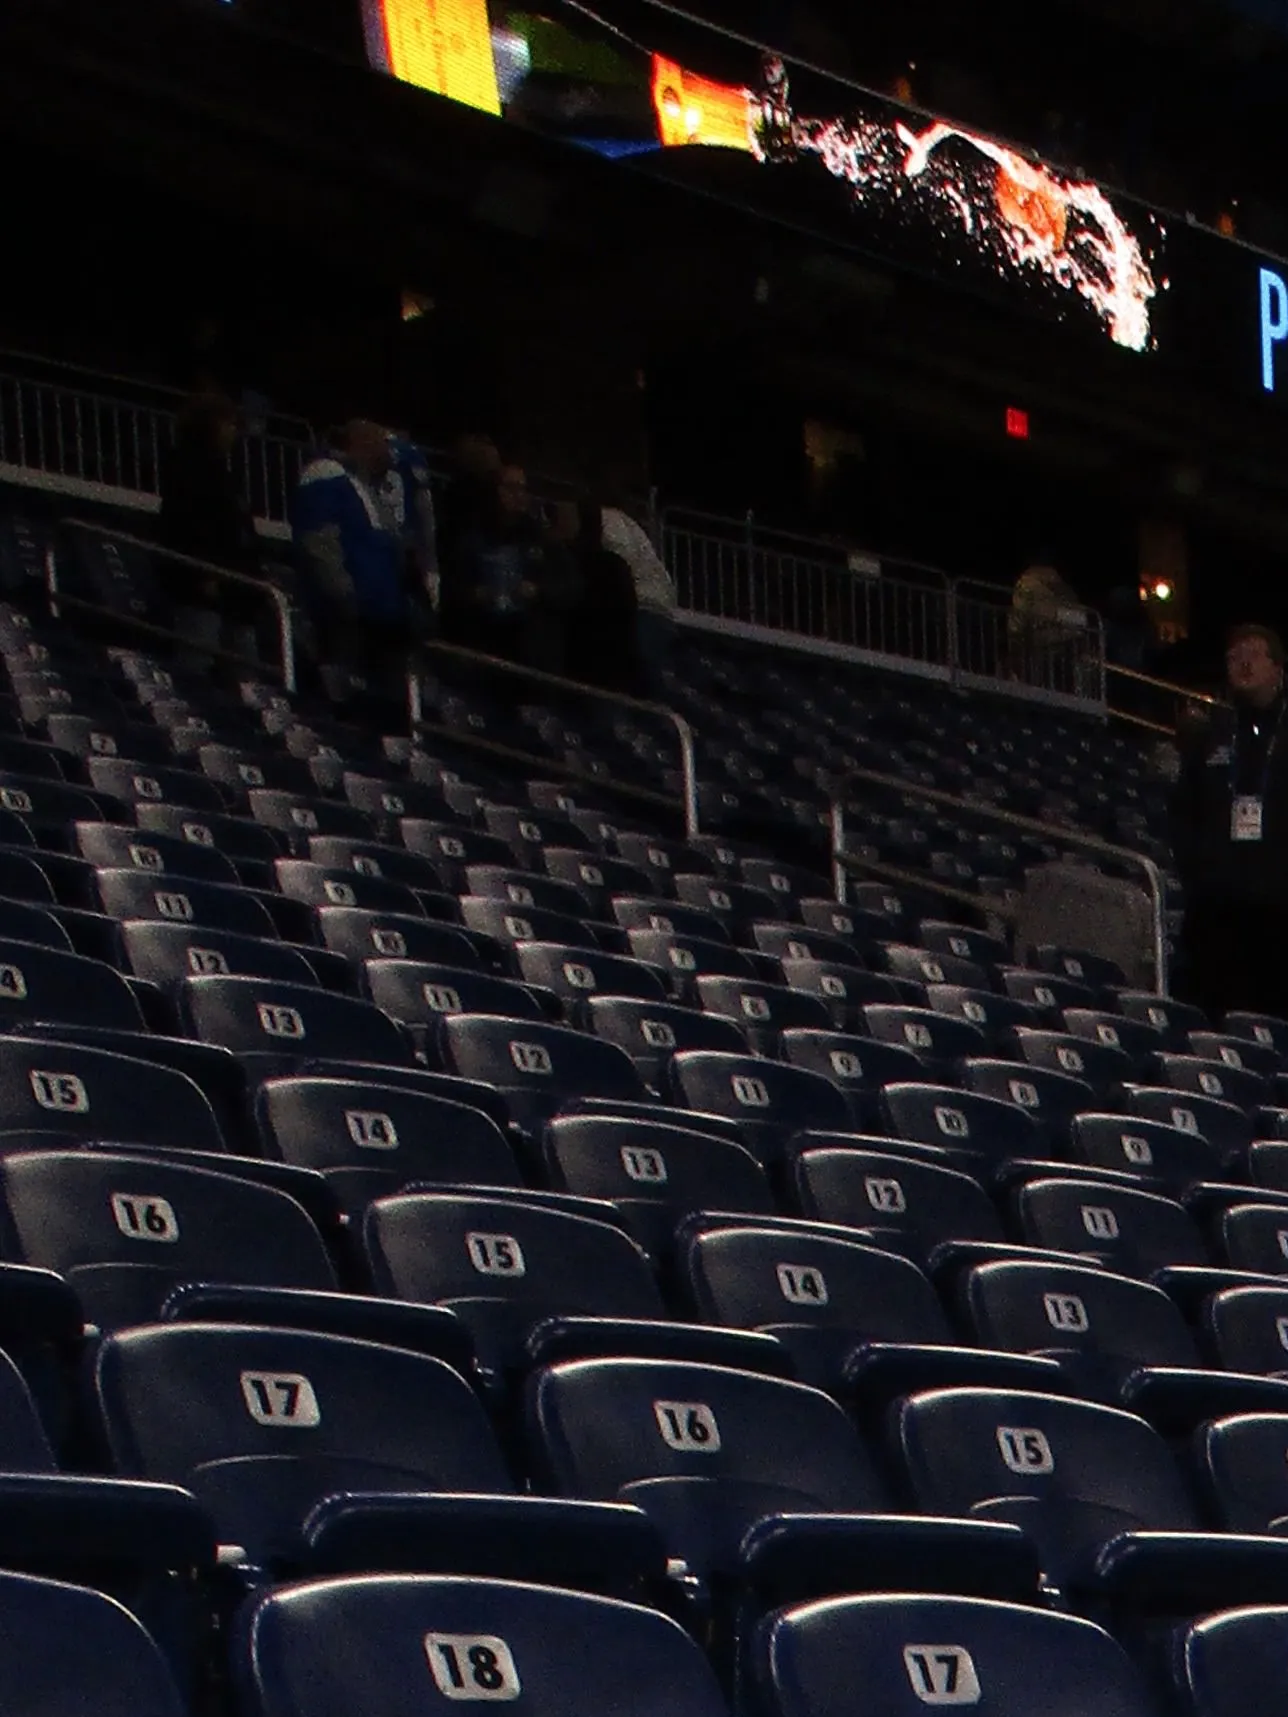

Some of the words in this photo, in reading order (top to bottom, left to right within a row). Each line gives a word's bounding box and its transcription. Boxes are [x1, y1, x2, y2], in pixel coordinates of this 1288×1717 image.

[162, 896, 186, 915] 11
[192, 952, 220, 975] 12
[430, 989, 457, 1011] 11
[266, 1009, 297, 1034] 13
[648, 1025, 672, 1044] 10
[517, 1047, 547, 1070] 12
[37, 1075, 77, 1105] 15
[739, 1082, 764, 1102] 11
[353, 1116, 389, 1144] 14
[943, 1113, 962, 1132] 10
[628, 1152, 659, 1176] 13
[872, 1184, 900, 1208] 12
[121, 1200, 167, 1235] 16
[1088, 1212, 1112, 1234] 11
[474, 1238, 514, 1270] 15
[784, 1270, 820, 1299] 14
[1050, 1300, 1082, 1326] 13
[250, 1379, 299, 1418] 17
[664, 1408, 710, 1444] 16
[1005, 1434, 1044, 1466] 15
[437, 1643, 504, 1690] 18
[911, 1654, 959, 1694] 17
